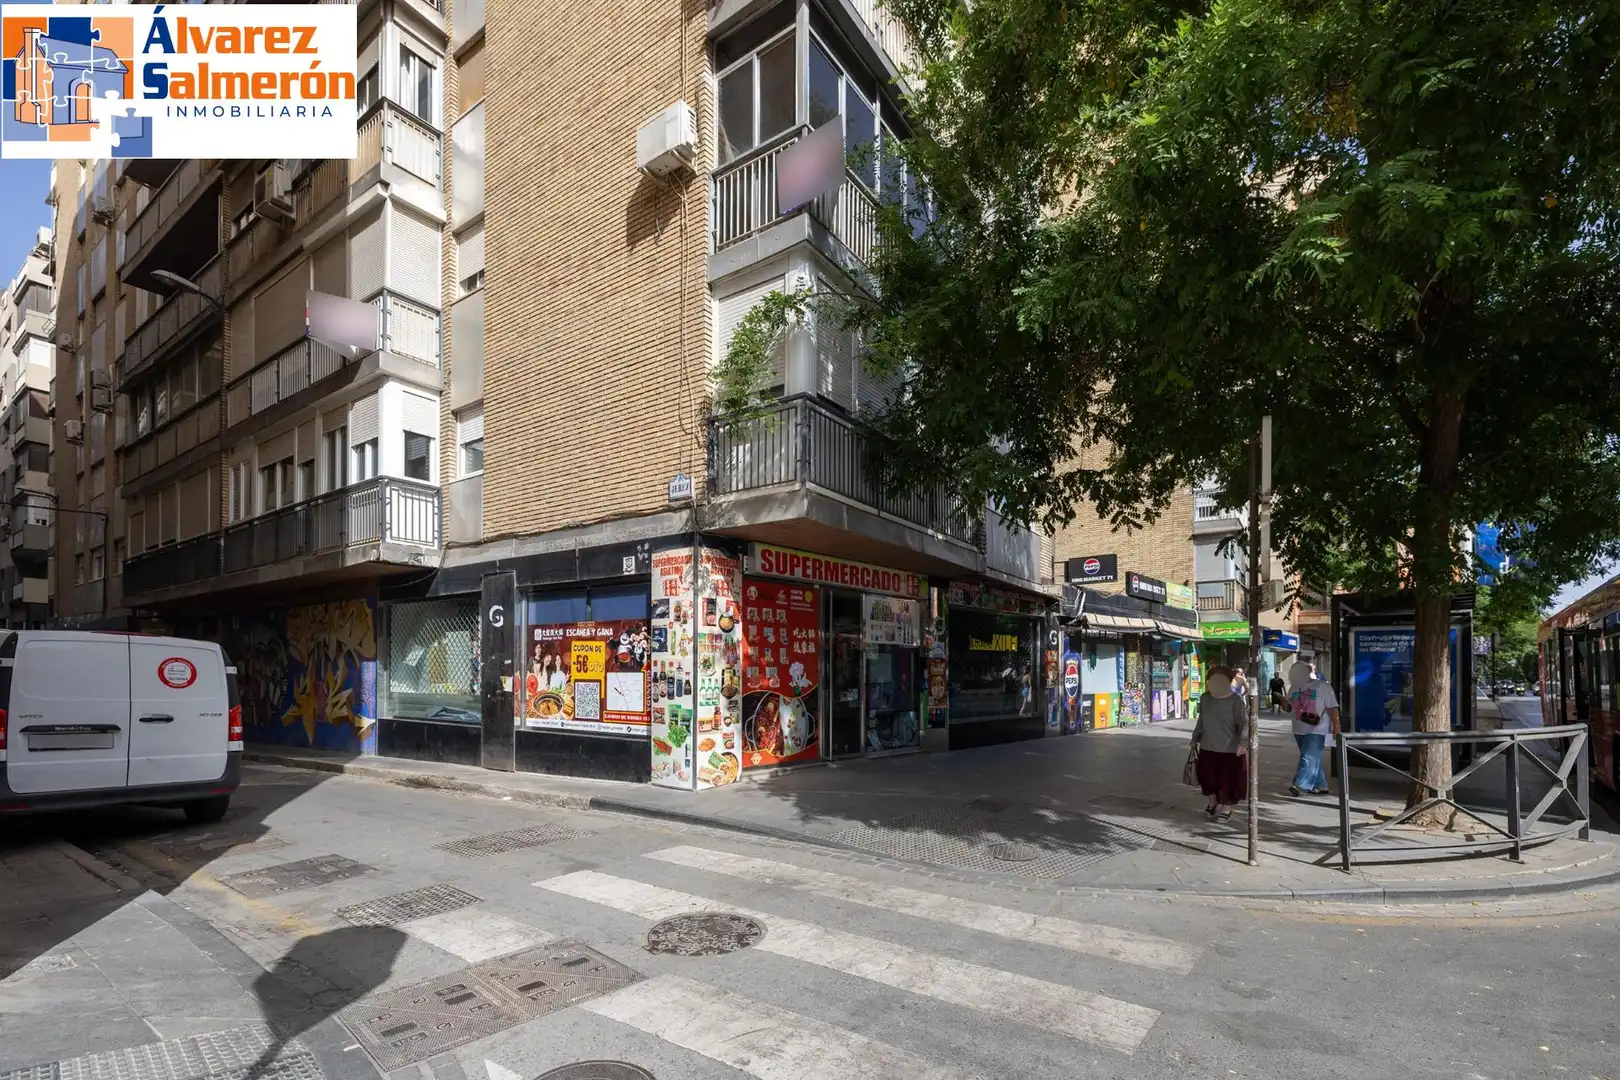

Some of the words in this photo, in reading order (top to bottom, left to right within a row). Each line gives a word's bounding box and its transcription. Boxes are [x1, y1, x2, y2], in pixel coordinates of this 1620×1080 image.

[760, 548, 901, 593] SUPERMERCADO
[566, 628, 591, 637] ESCANEA
[591, 628, 596, 636] Y
[597, 627, 613, 636] GANA
[594, 645, 602, 653] DE
